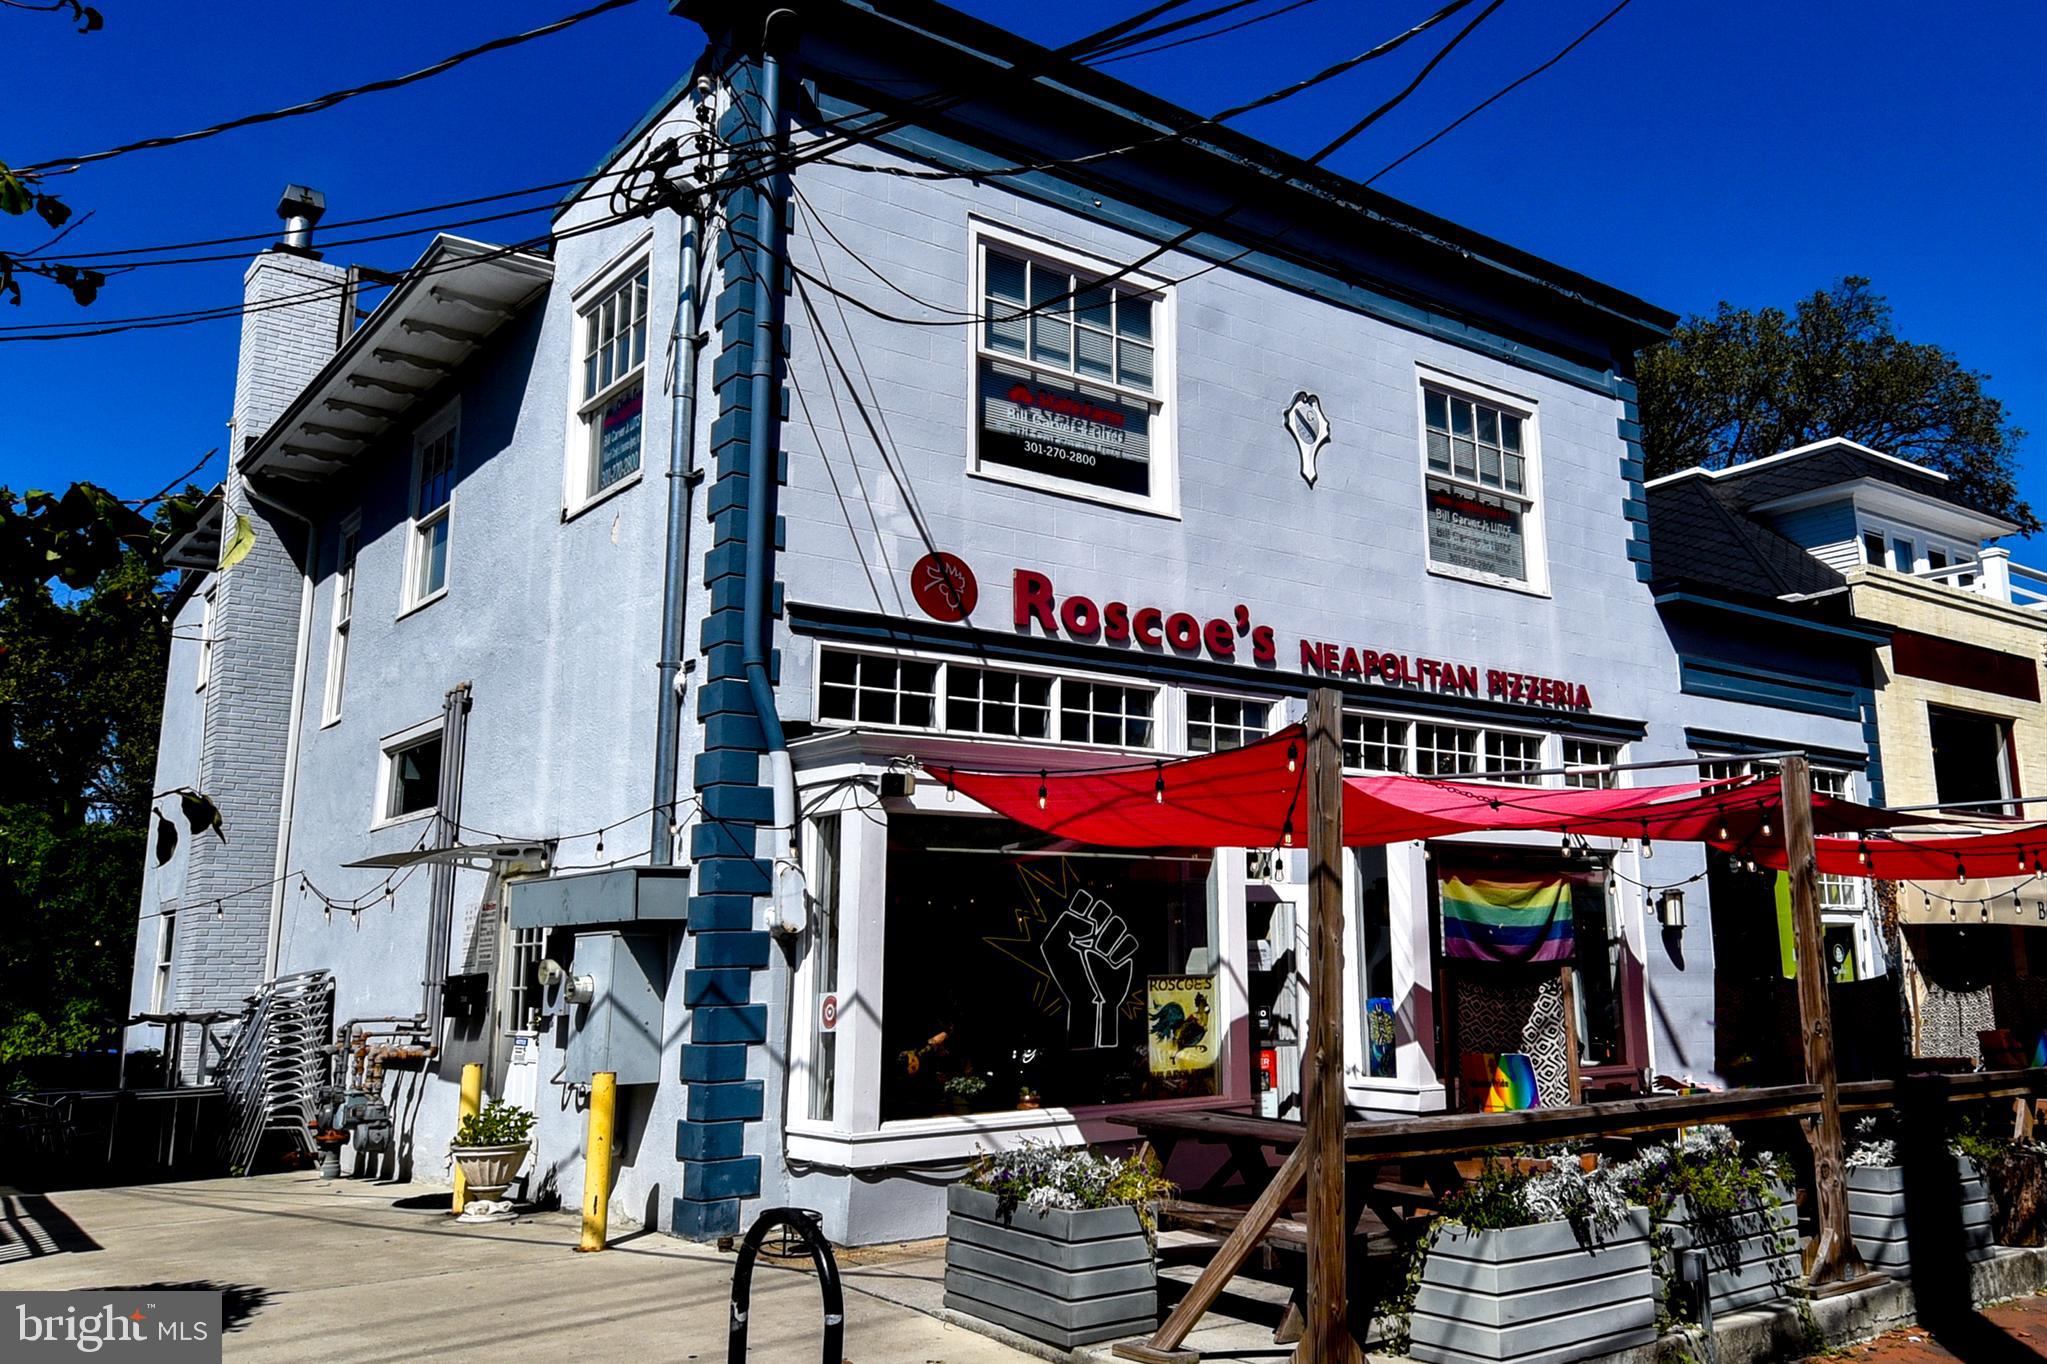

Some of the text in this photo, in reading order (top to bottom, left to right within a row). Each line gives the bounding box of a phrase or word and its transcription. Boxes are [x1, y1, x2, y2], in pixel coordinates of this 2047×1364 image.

[1023, 440, 1097, 467] 301-270-2800
[1435, 507, 1450, 523] Bill
[1013, 567, 1593, 709] Roscoe's NEAPOLITAN PIZZERIA
